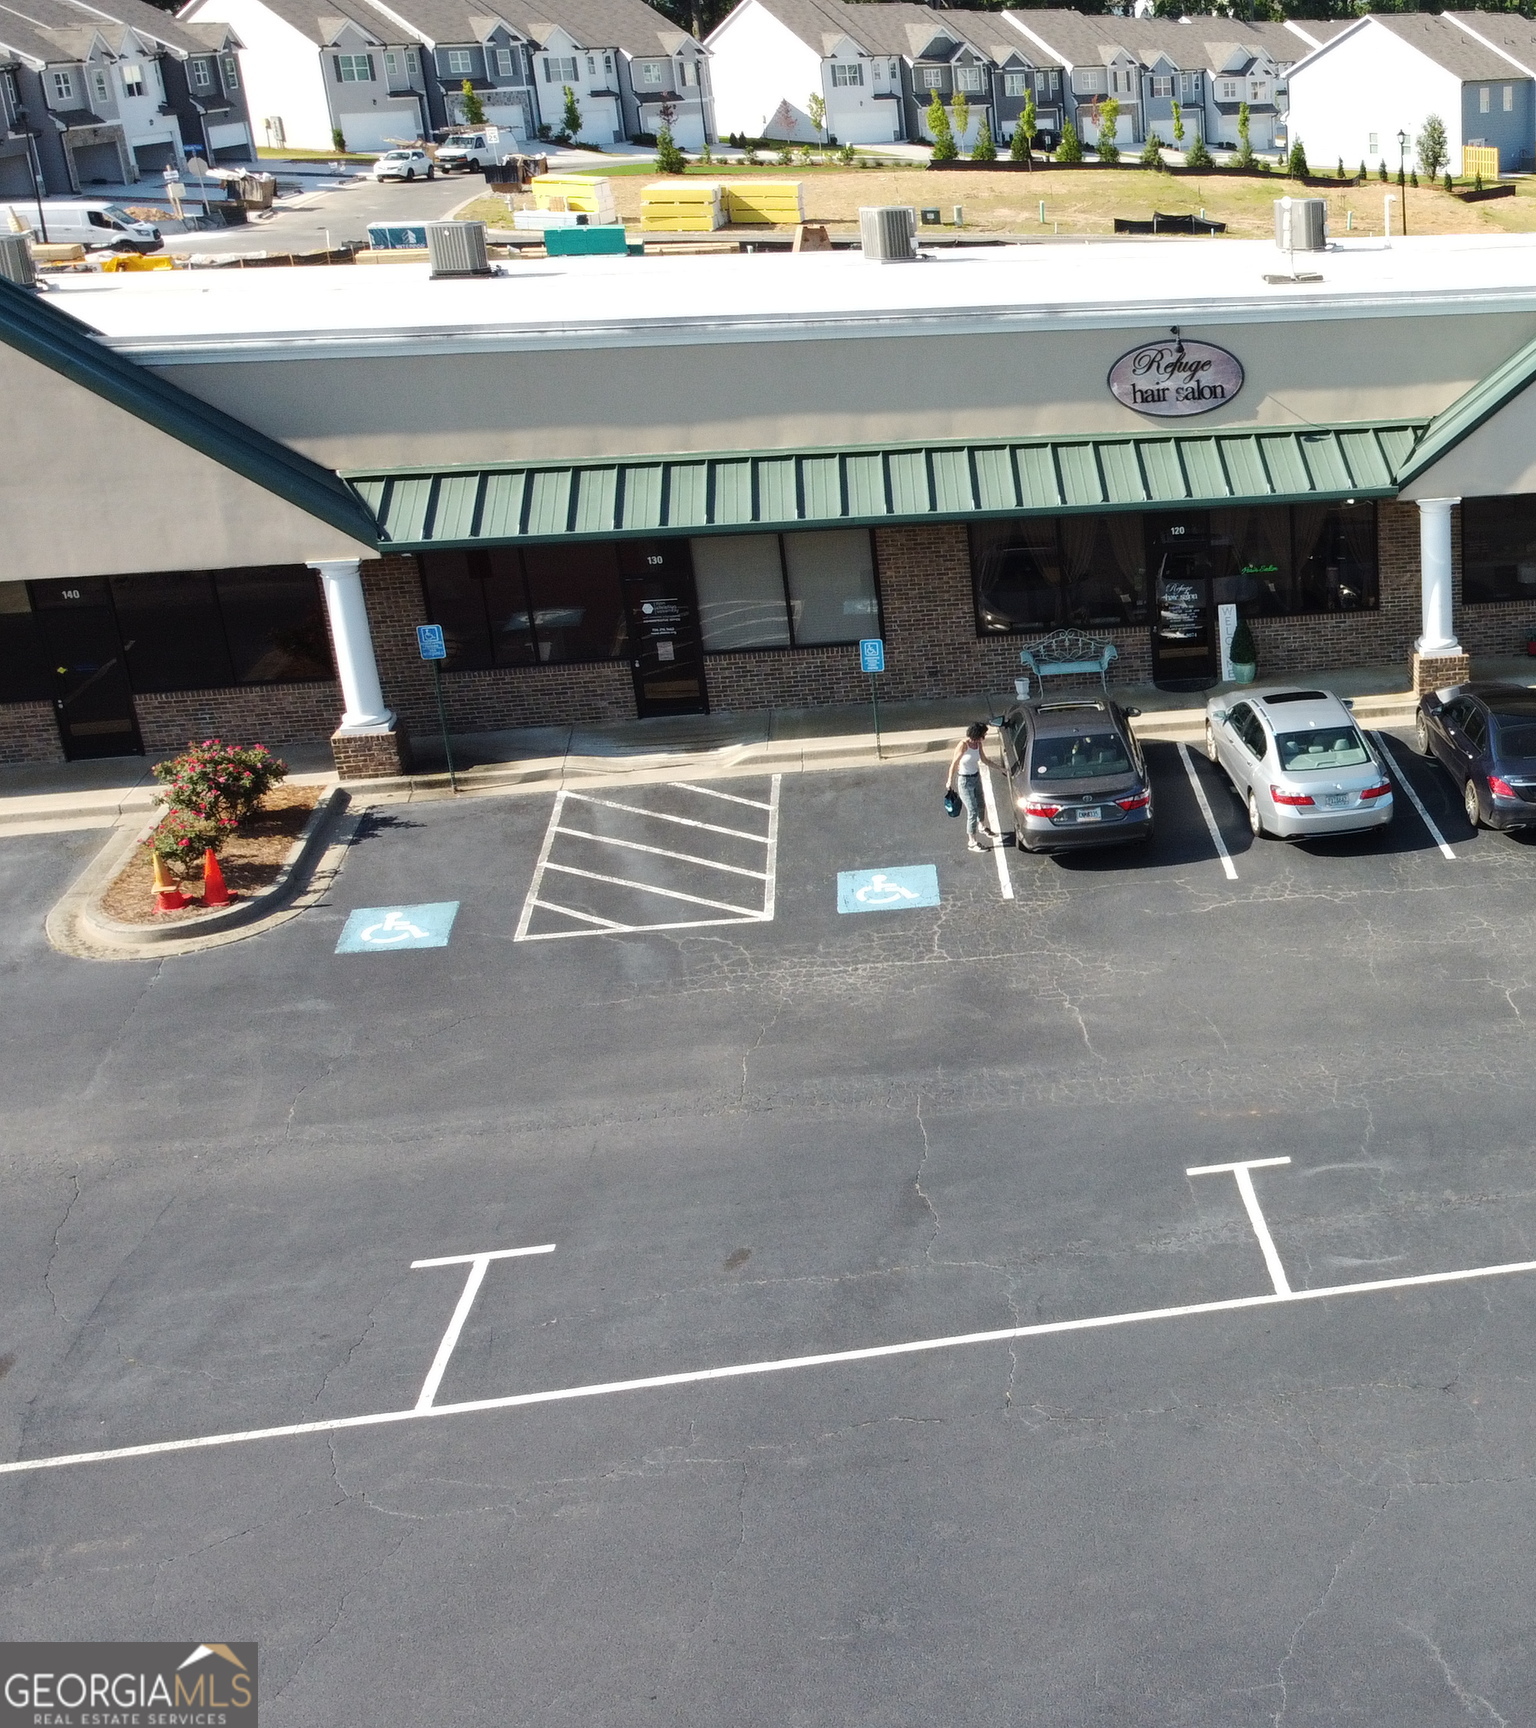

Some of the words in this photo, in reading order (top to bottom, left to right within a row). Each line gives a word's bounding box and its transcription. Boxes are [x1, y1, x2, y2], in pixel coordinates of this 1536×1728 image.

[1132, 348, 1212, 384] Refuge
[1131, 382, 1170, 404] hair
[1175, 379, 1227, 402] salon
[1170, 526, 1185, 535] 120
[646, 556, 664, 565] 130
[62, 589, 80, 600] 140
[1221, 606, 1236, 679] WELCME
